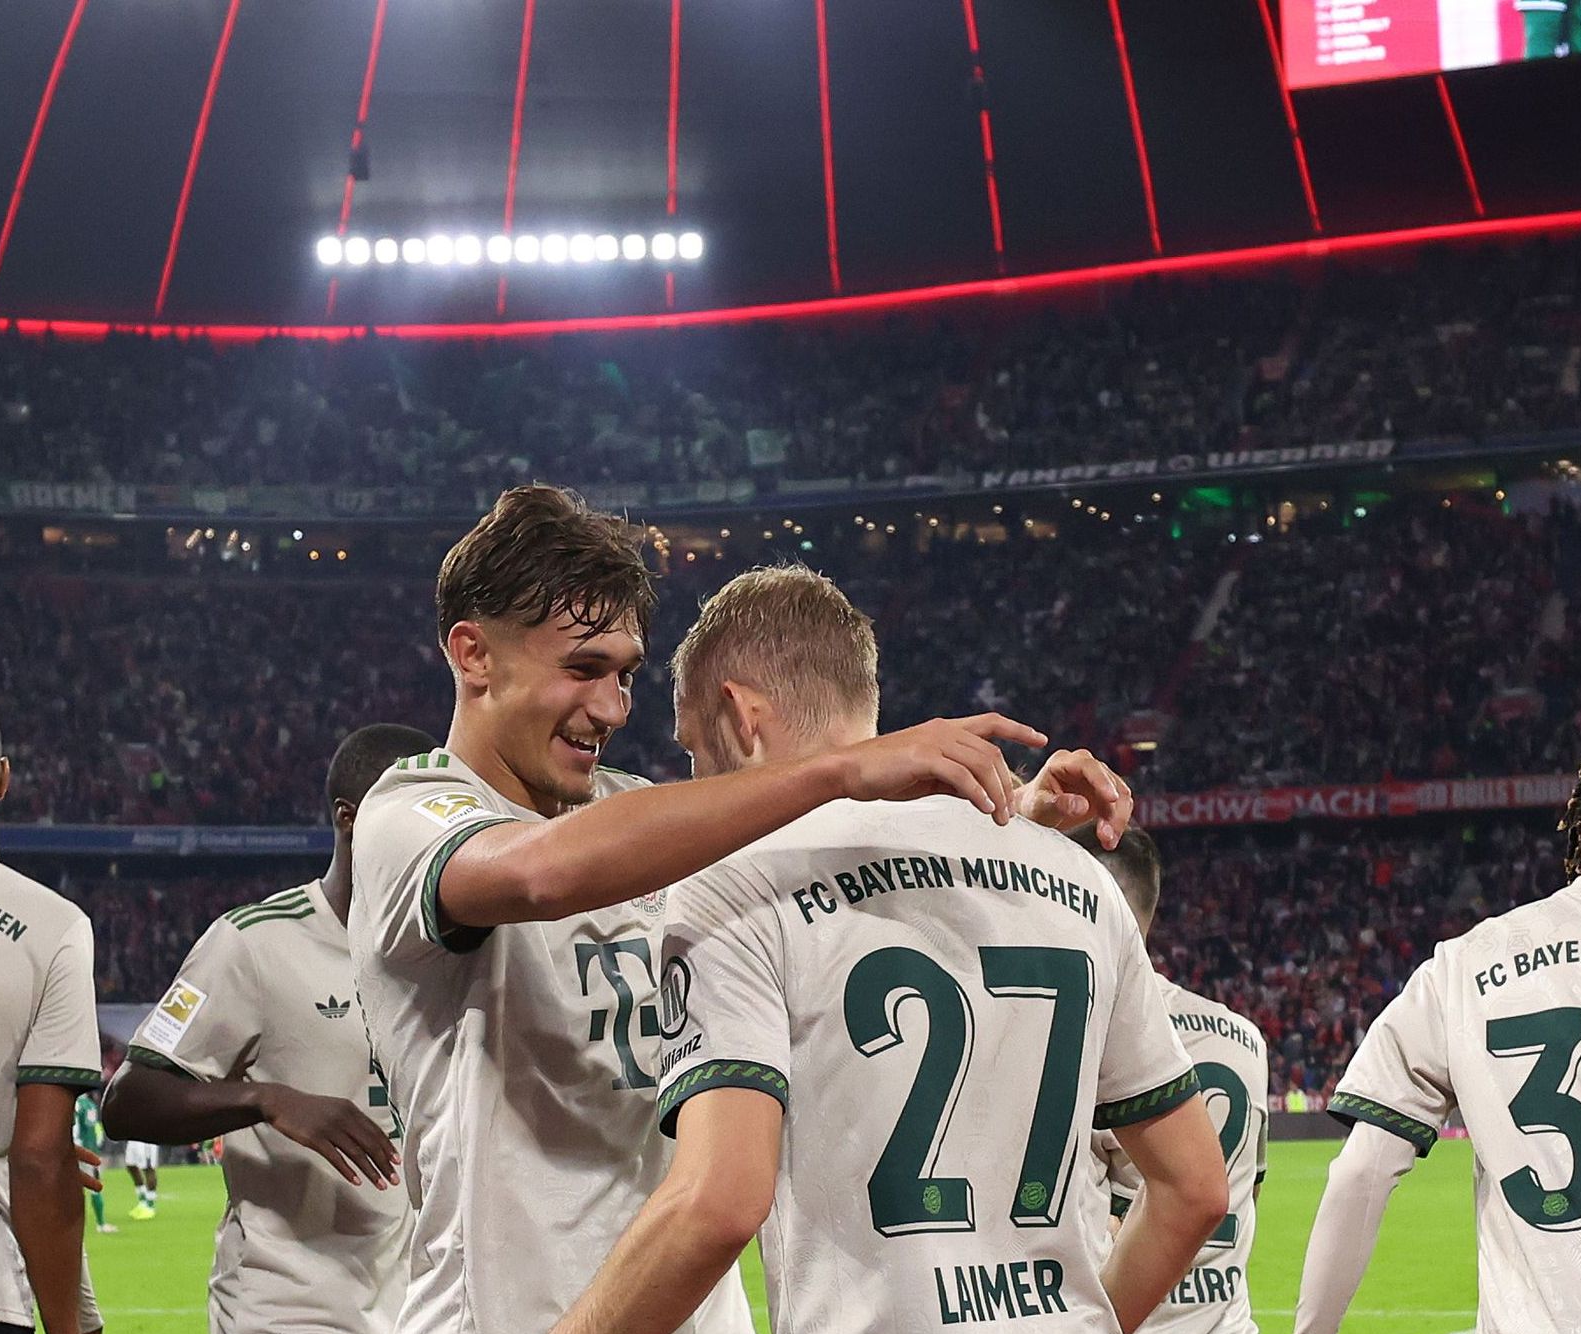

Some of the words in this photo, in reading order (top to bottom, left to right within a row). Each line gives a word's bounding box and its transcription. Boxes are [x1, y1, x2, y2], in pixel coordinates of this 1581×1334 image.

[793, 883, 836, 924] FC
[841, 857, 953, 904] BAYERN
[962, 856, 1099, 924] MÜNCHEN
[1475, 962, 1508, 996] FC
[1170, 1013, 1259, 1059] MÜNCHEN
[844, 946, 1101, 1238] 27
[1192, 1061, 1252, 1249] 2
[935, 1259, 1068, 1325] LAIMER
[1171, 1266, 1242, 1305] EIRO
